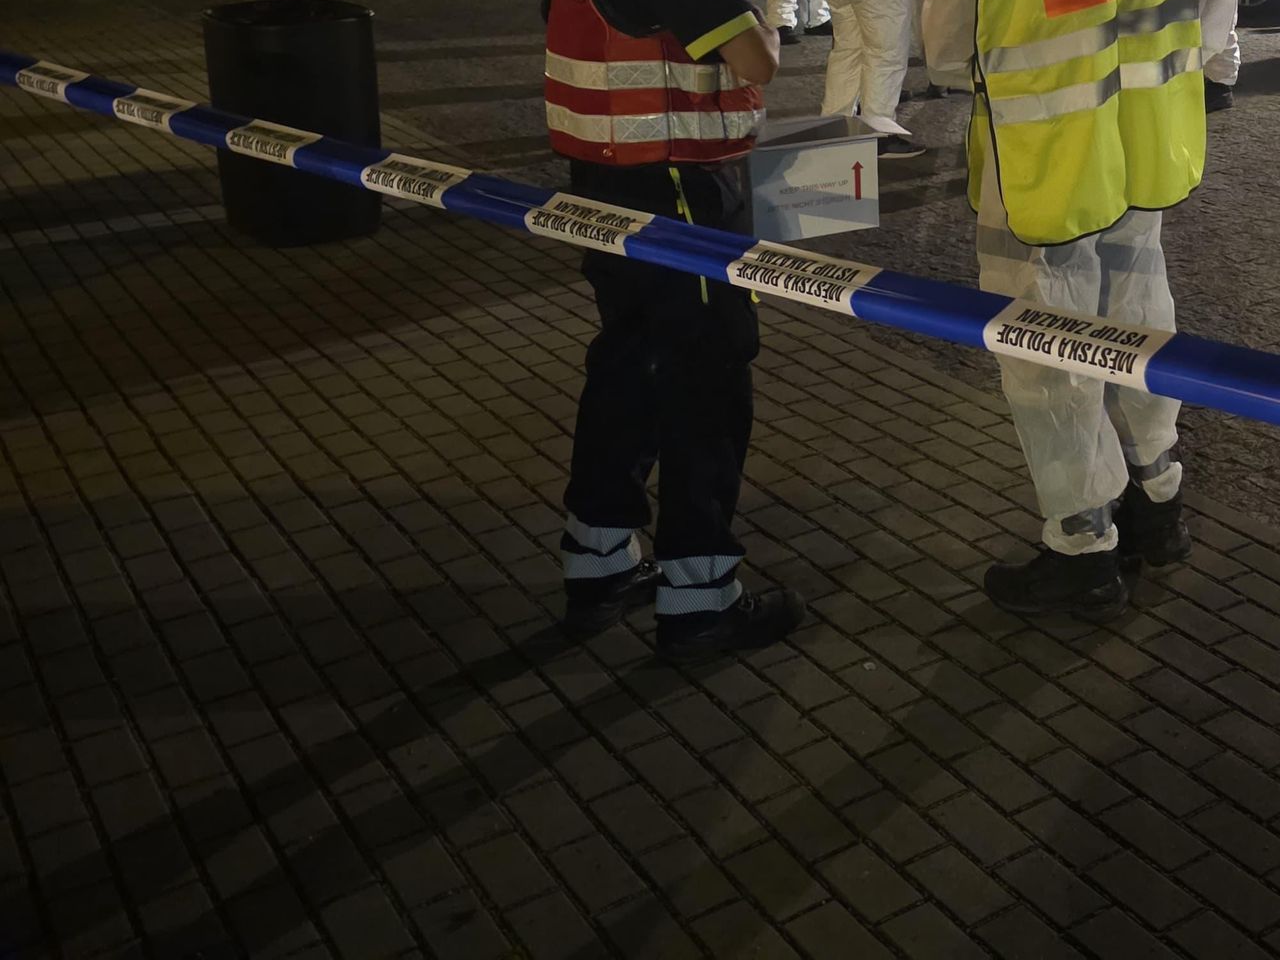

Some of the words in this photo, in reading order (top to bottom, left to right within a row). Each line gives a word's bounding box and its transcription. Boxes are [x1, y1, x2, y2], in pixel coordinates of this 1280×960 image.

[532, 210, 570, 232] POLICIE
[736, 262, 780, 287] POLICIE
[814, 263, 860, 282] VSTUP
[1015, 309, 1093, 335] ZAKÁZÁN
[996, 323, 1056, 354] POLICIE
[1089, 325, 1149, 347] VSTUP
[1058, 337, 1138, 375] MĚSTSKÁ
